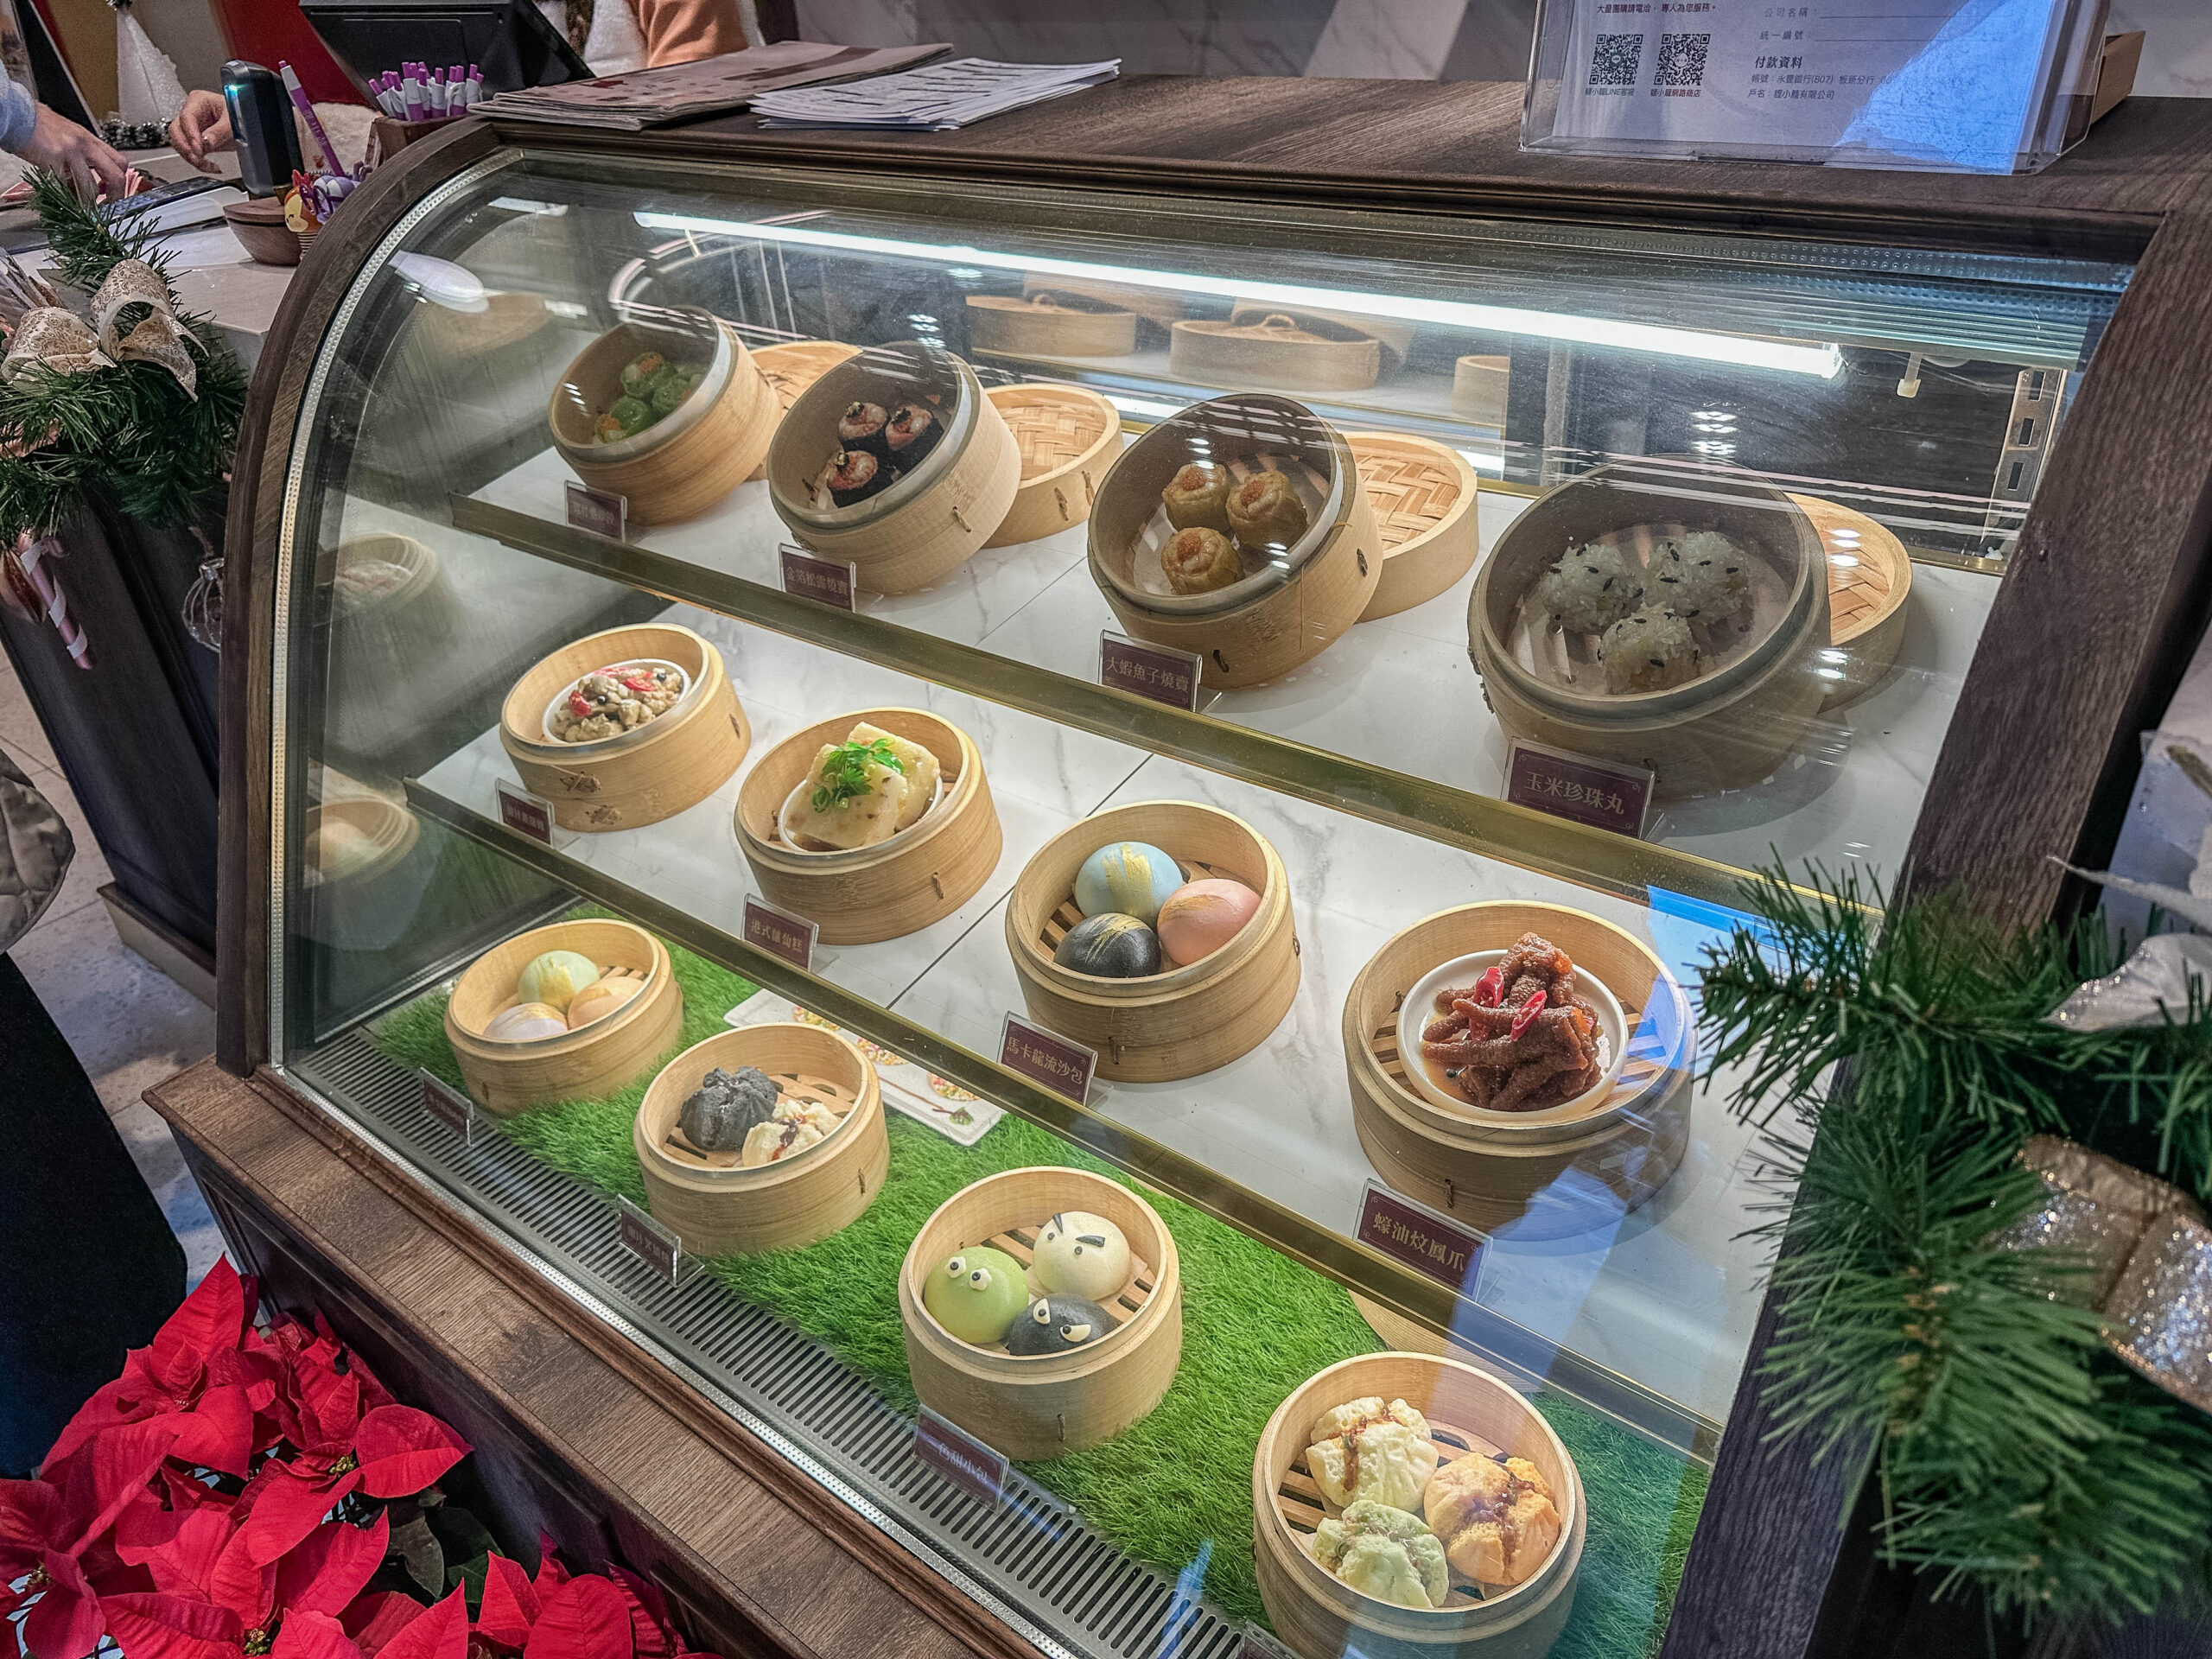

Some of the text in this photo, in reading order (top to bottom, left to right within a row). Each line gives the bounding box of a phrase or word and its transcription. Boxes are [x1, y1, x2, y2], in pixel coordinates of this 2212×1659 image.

[1754, 55, 1802, 69] 付款資料
[1106, 656, 1189, 692] 大蝦魚子燒賣
[1523, 771, 1624, 815] 玉米珍珠丸
[1006, 1036, 1083, 1084] 馬卡龍流沙包
[1373, 1211, 1465, 1272] 蠔油炆鳳爪
